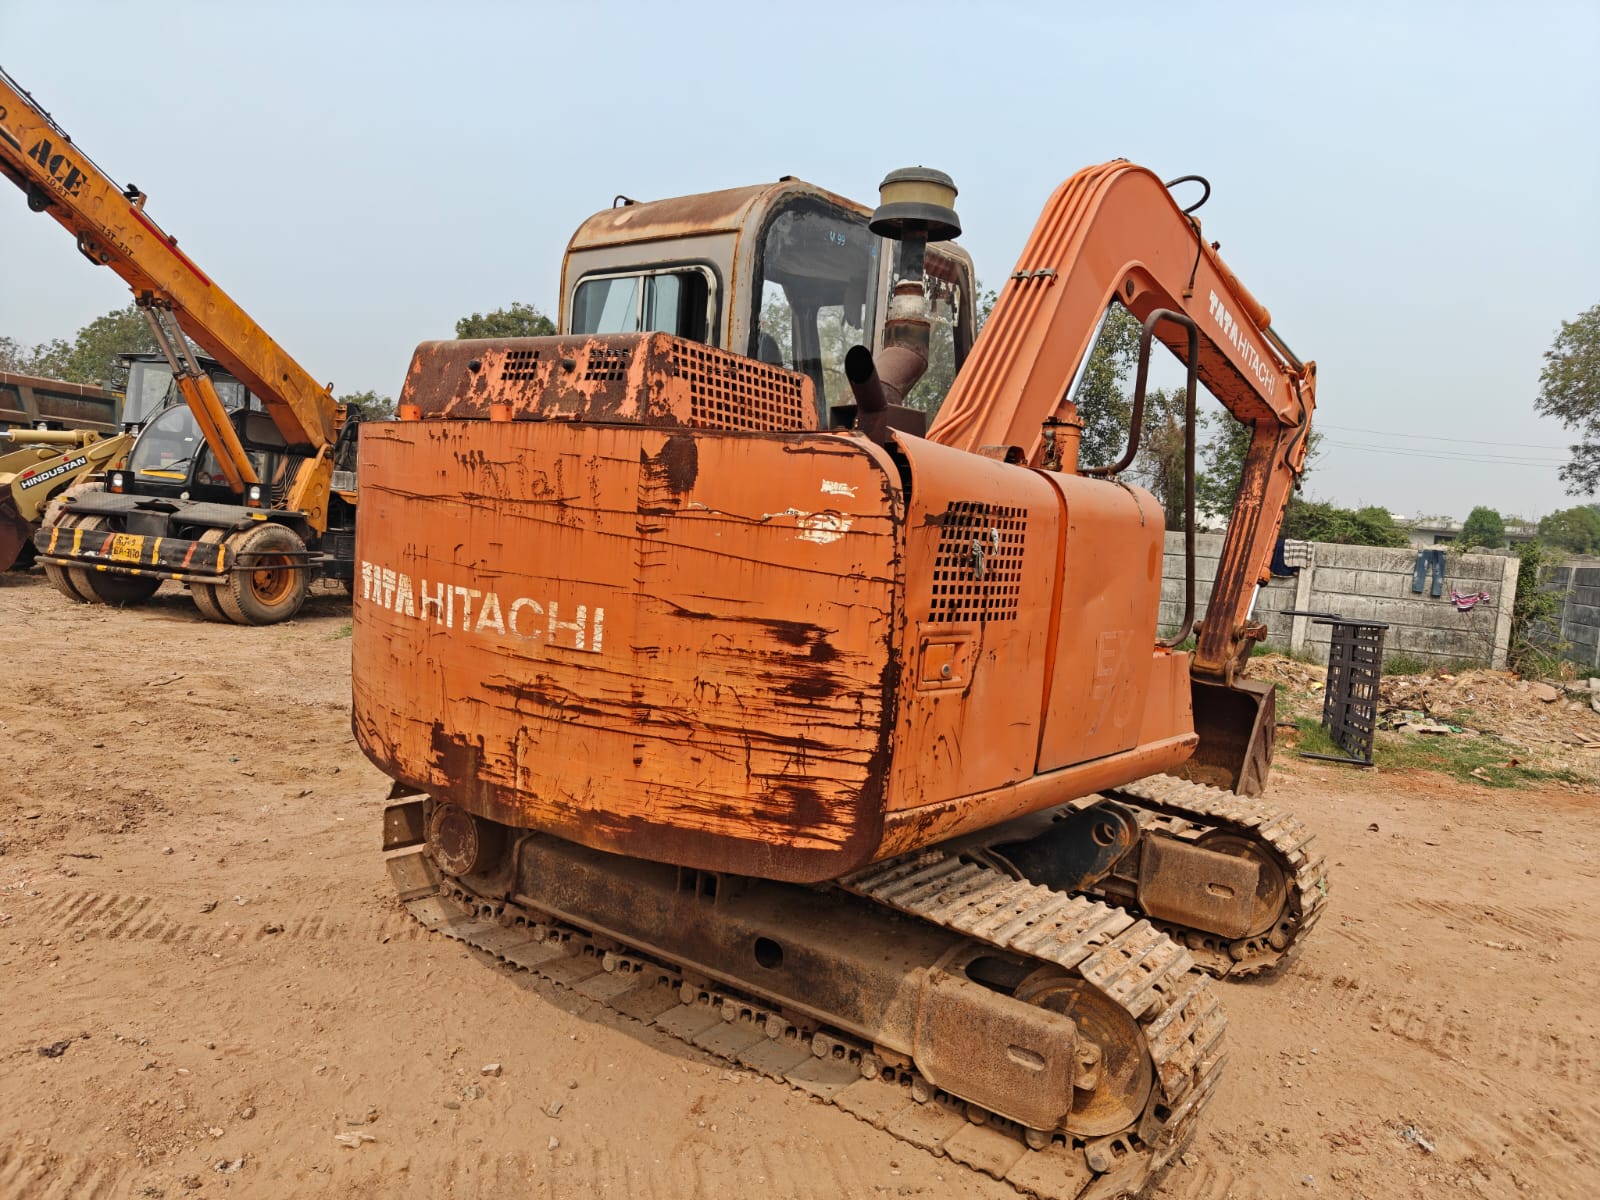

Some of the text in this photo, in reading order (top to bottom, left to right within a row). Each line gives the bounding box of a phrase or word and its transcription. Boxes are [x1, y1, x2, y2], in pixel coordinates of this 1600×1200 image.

[28, 138, 89, 198] ACE
[1209, 289, 1276, 396] TATA HITACHI
[21, 456, 86, 489] HINDUSTAN
[361, 560, 605, 653] TATA HITACHI
